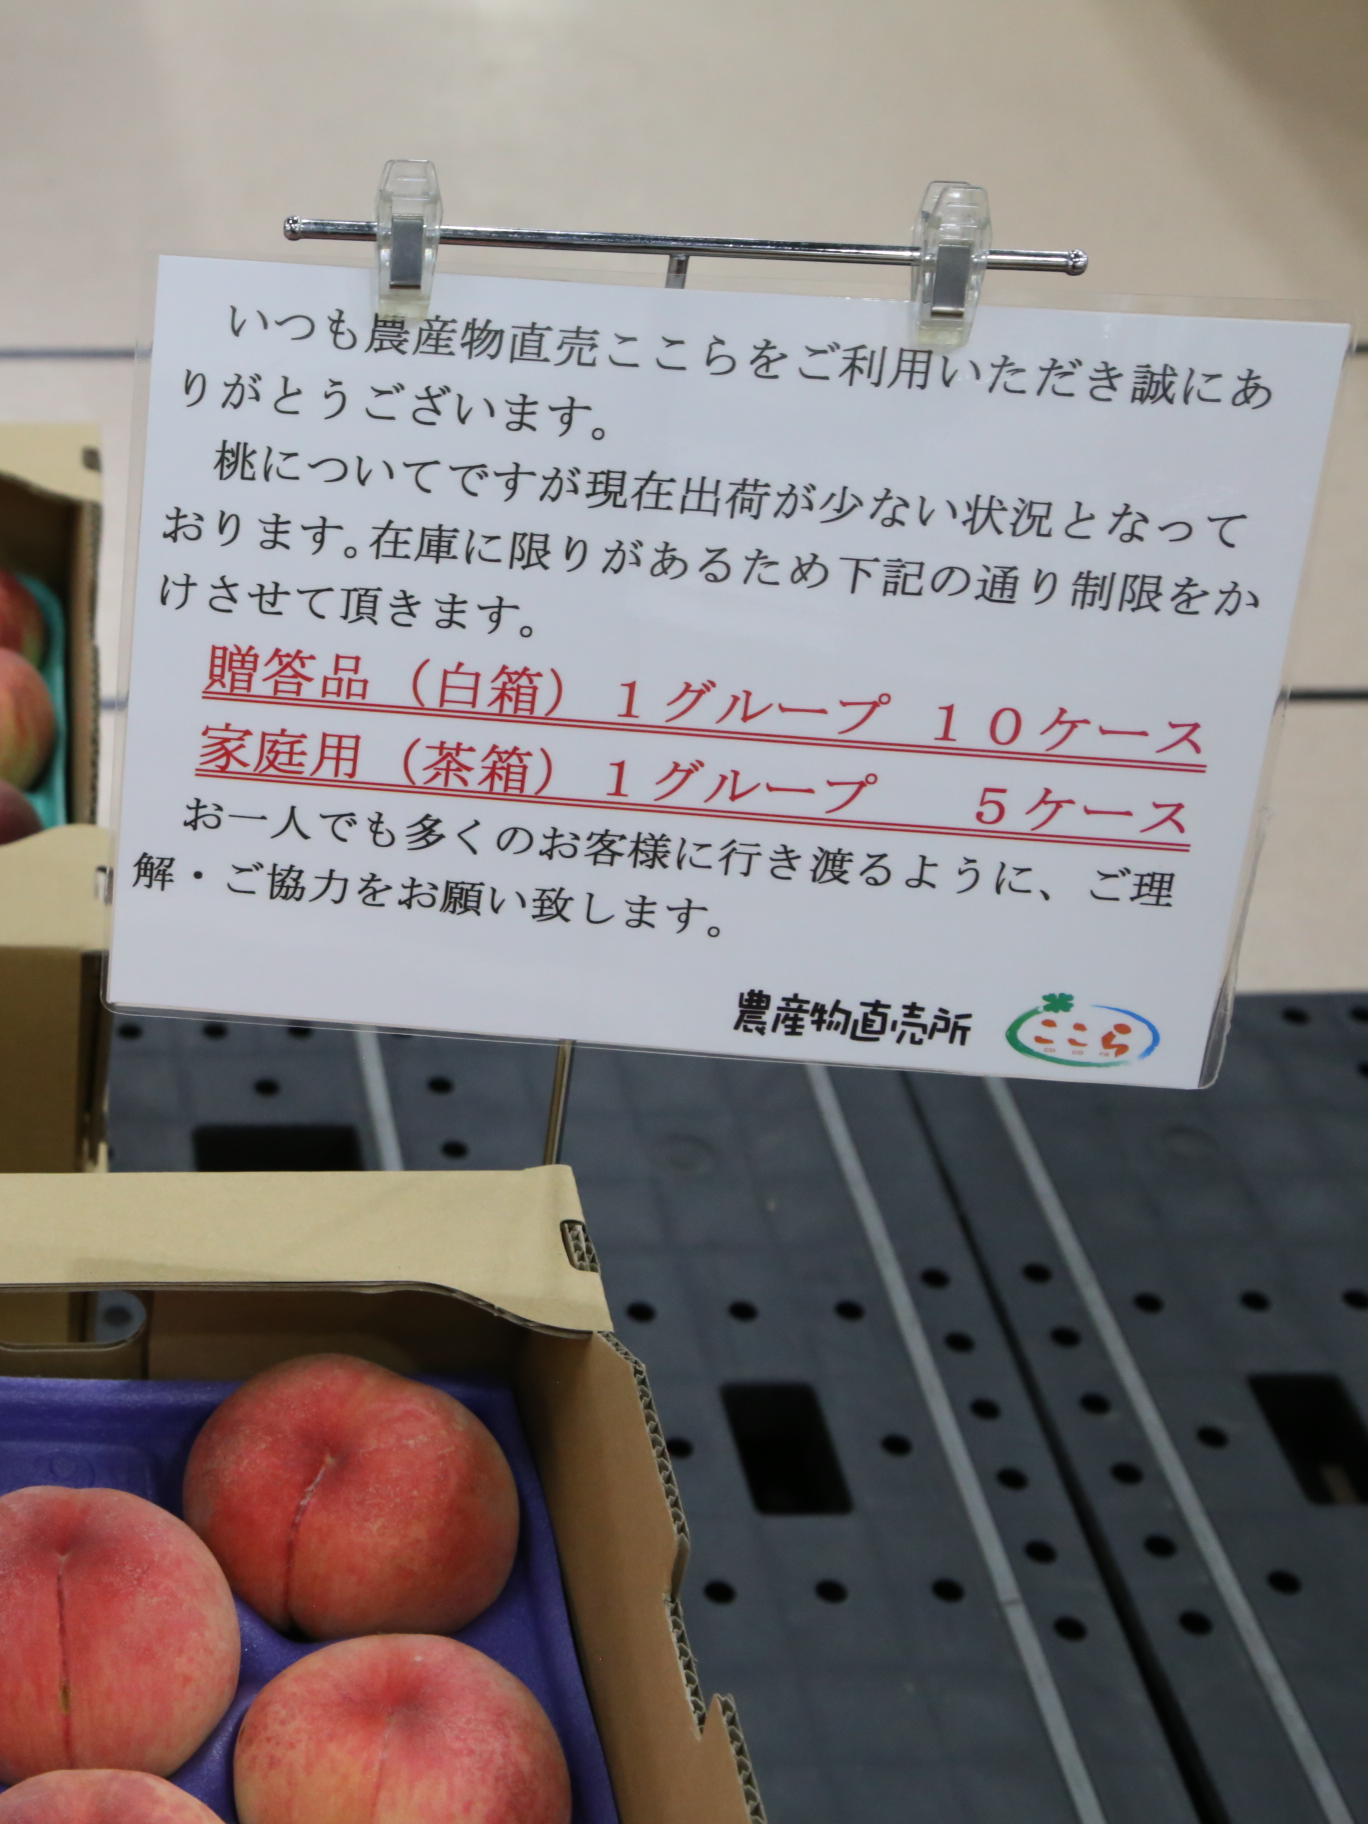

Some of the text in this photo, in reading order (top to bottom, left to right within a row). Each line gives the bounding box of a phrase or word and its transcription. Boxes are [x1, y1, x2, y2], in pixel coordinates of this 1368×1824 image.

[229, 304, 1273, 411] いつも農産物直売ここらをご利用いただき誠にあ
[183, 368, 607, 441] りがとうございます。
[213, 439, 1249, 548] 桃についてですが現在出荷が少ない状況となって
[161, 506, 1260, 616] おります。在庫に限りがあるため下記の通り制限をか
[158, 573, 534, 638] けさせて頂きます。
[131, 850, 721, 939] 解・ご協力をお願い致します。
[733, 989, 973, 1046] 農産物直売所
[1034, 1018, 1132, 1058] ここら
